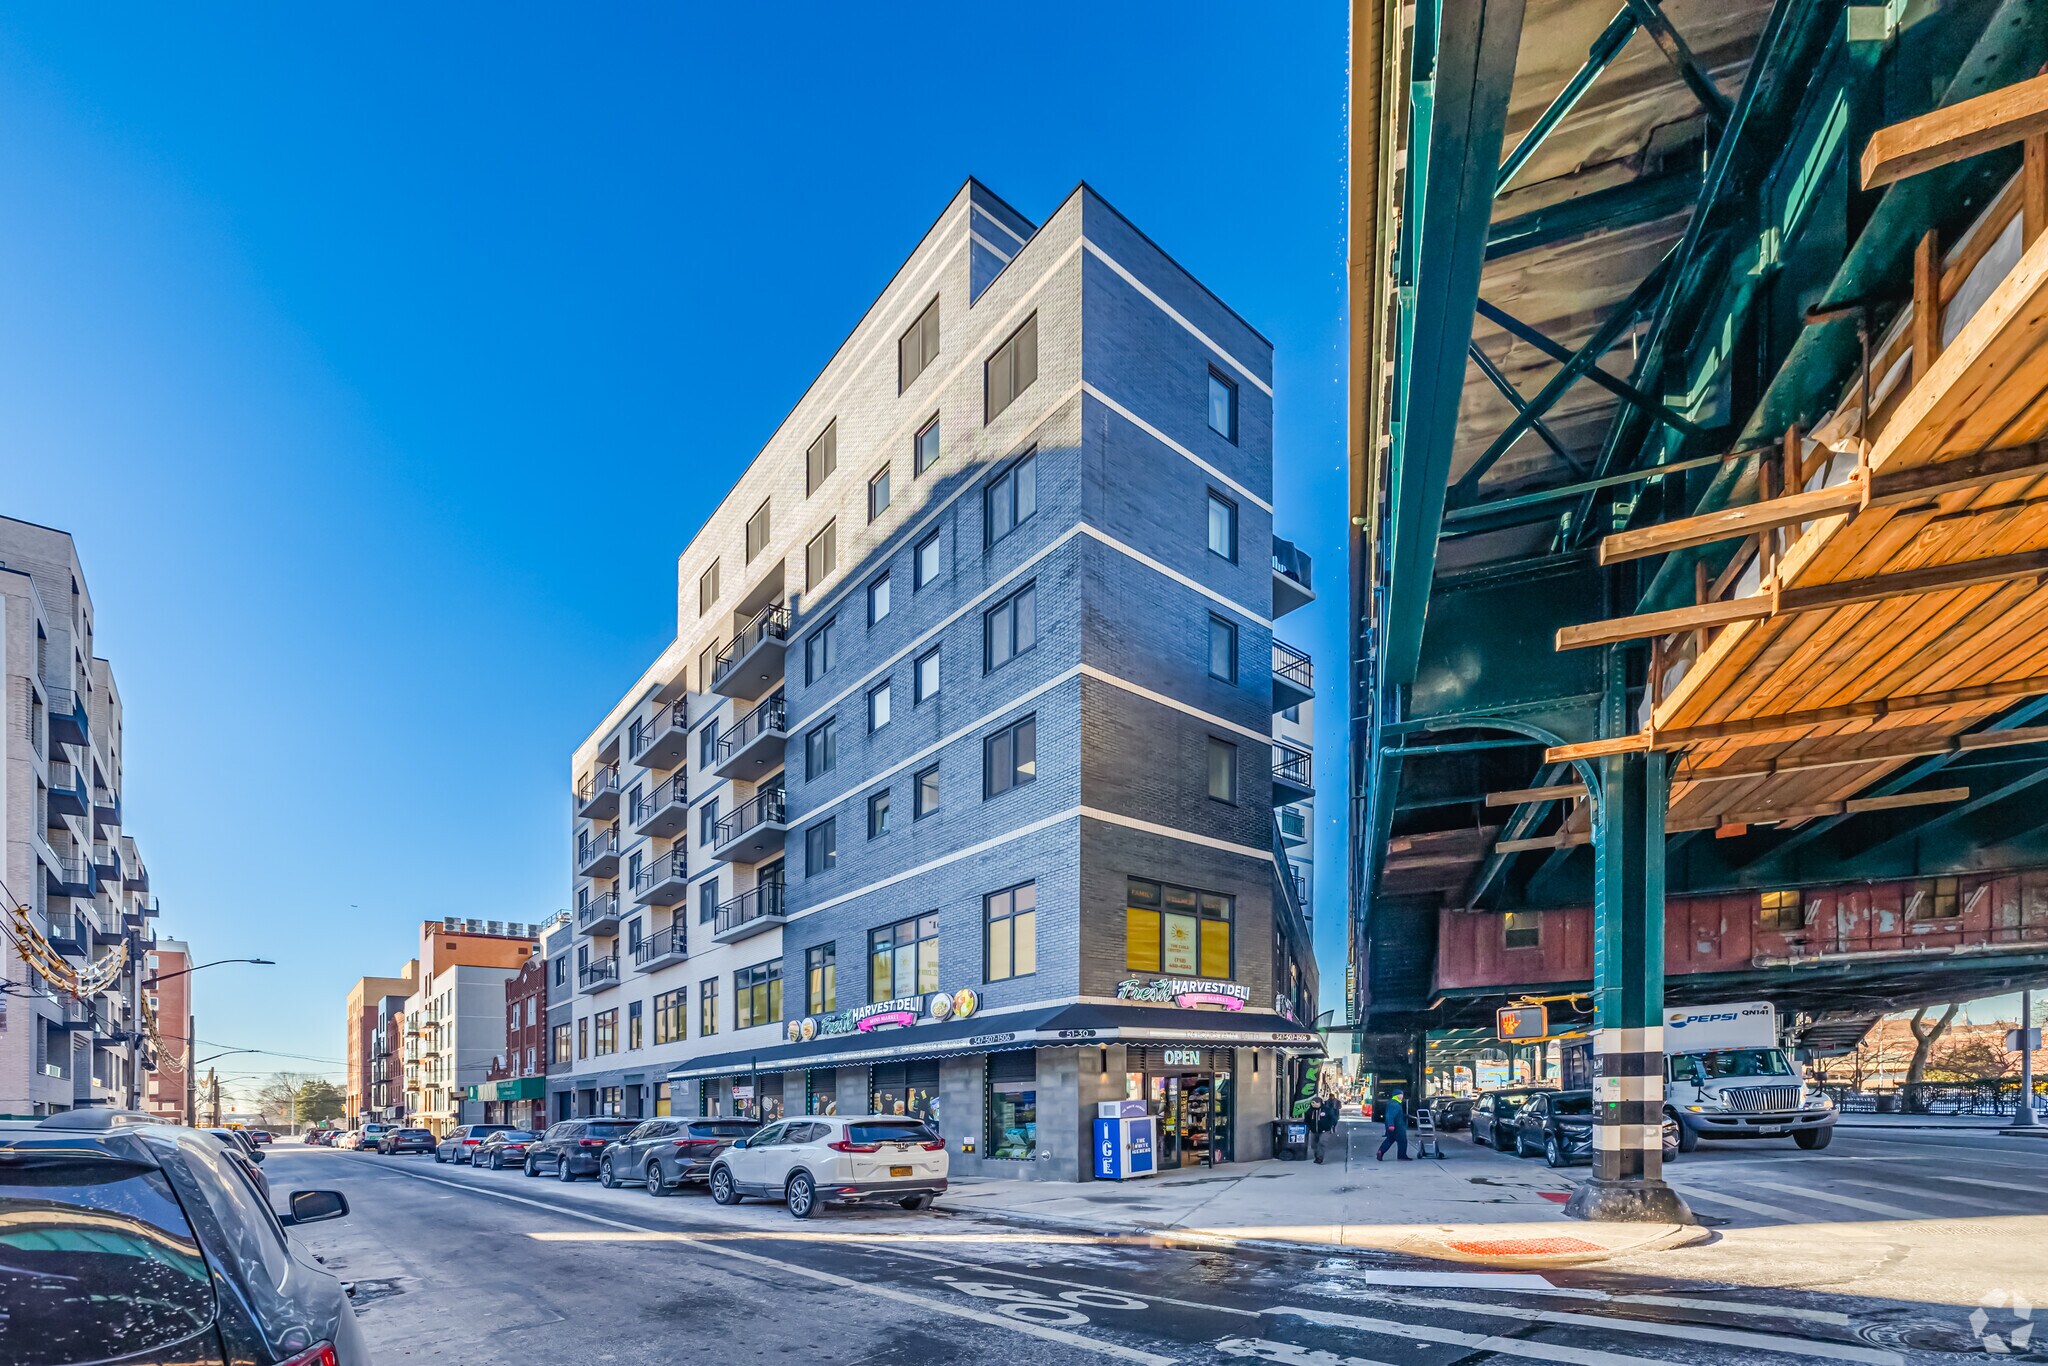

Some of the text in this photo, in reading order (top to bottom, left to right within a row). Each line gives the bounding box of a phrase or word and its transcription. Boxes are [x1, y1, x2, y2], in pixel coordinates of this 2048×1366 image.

[1118, 979, 1250, 1002] Fresh HARVEST DELI
[1208, 995, 1229, 1003] MARKET
[821, 997, 920, 1035] Fresh HARVEST DELI
[869, 1014, 899, 1025] MINI MARKET
[1687, 1013, 1738, 1023] PEPSI
[974, 1034, 1011, 1045] 347-507-1506
[1164, 1050, 1200, 1065] OPEN
[1102, 1122, 1113, 1174] ICE
